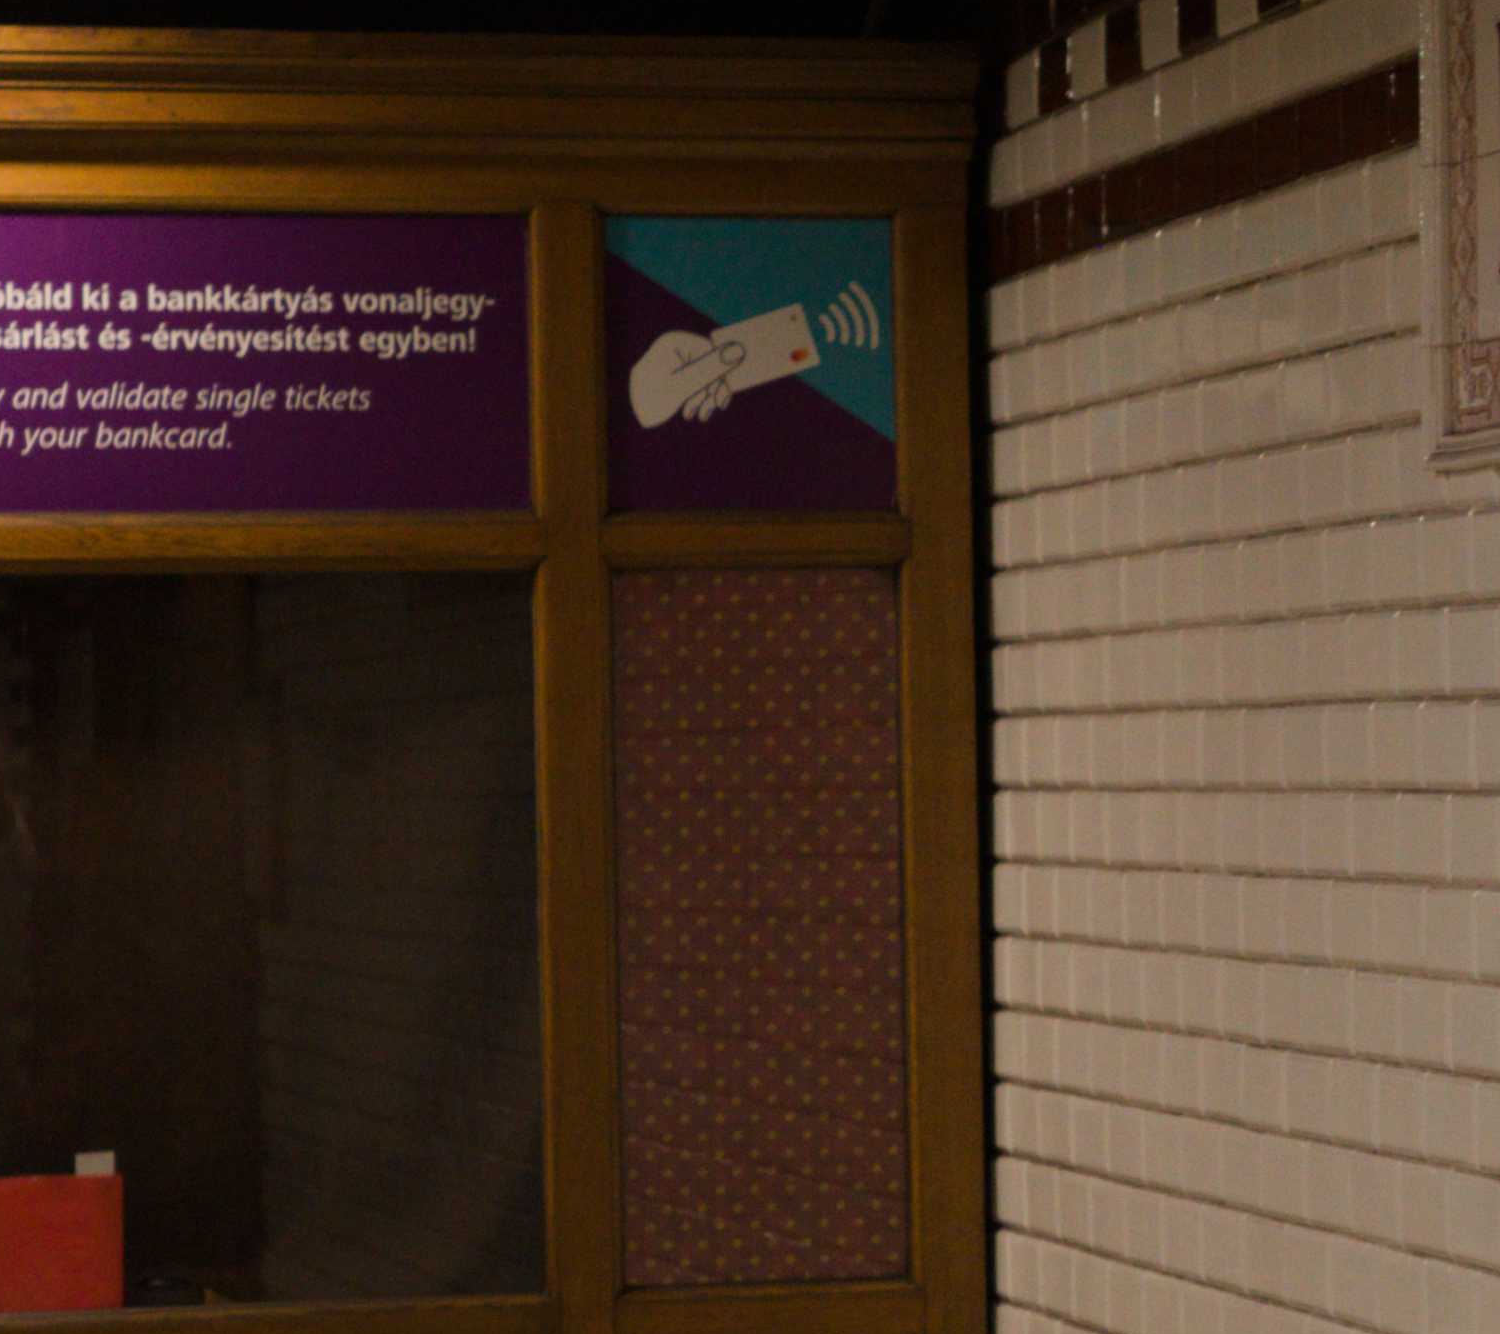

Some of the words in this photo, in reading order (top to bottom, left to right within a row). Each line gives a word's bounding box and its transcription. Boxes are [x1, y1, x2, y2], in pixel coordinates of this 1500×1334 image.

[82, 282, 110, 312] ki
[118, 289, 138, 312] a
[147, 284, 333, 320] bankkártyás
[342, 287, 496, 322] vonaljegy-
[99, 322, 132, 351] és
[140, 323, 350, 358] -érvényesítést
[358, 328, 478, 359] egyben!
[12, 382, 68, 411] and
[76, 382, 187, 412] validate
[195, 382, 276, 419] single
[284, 384, 372, 412] tickets
[21, 428, 87, 456] your
[95, 421, 233, 450] bankcard.
